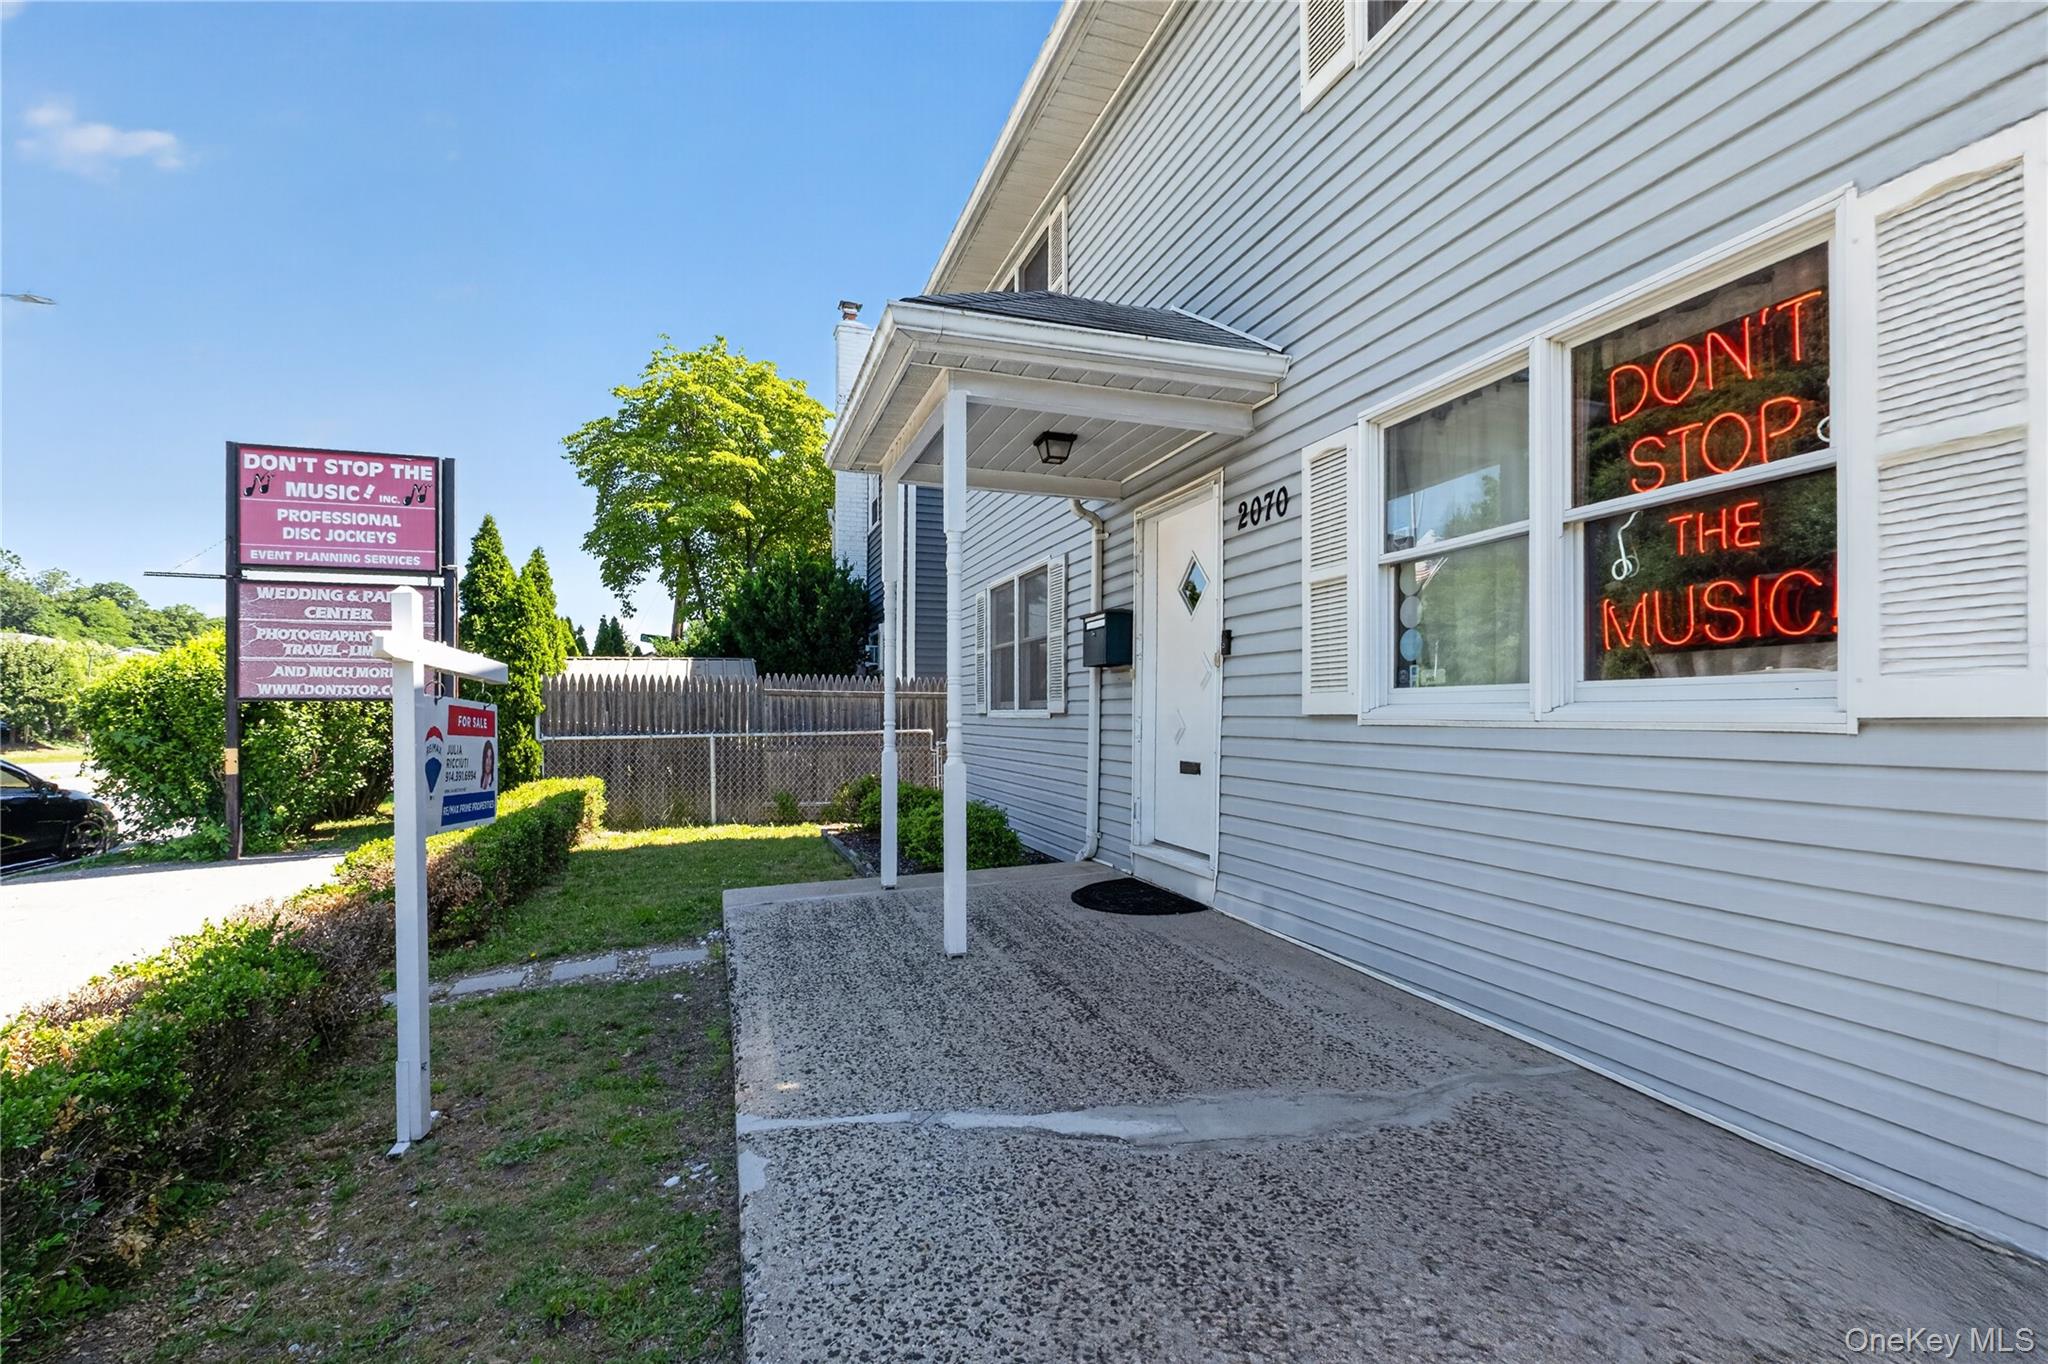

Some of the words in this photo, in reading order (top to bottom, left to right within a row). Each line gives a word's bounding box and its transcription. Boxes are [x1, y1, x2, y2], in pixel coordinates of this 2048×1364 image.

[1609, 290, 1823, 424] DON'T
[1629, 396, 1802, 494] STOP
[243, 453, 318, 474] DON'T
[324, 459, 384, 478] STOP
[390, 463, 433, 481] THE
[379, 495, 400, 504] INC.
[1237, 485, 1289, 531] 2070
[277, 508, 401, 527] PROFESSIONAL
[283, 526, 321, 541] DISC
[325, 530, 397, 545] JOCKEYS
[1667, 501, 1761, 556] THE
[250, 549, 292, 561] EVENT
[296, 551, 360, 564] PLANNING
[364, 554, 421, 566] SERVICES
[256, 586, 343, 602] WEDDING
[346, 590, 359, 602] &
[304, 606, 373, 620] CENTER
[256, 628, 369, 643] PHOTOGRAPHY
[271, 665, 307, 678] AND
[309, 665, 353, 678] MUCH
[458, 715, 472, 728] FOR
[473, 717, 488, 729] SALE
[447, 744, 463, 756] JULIA
